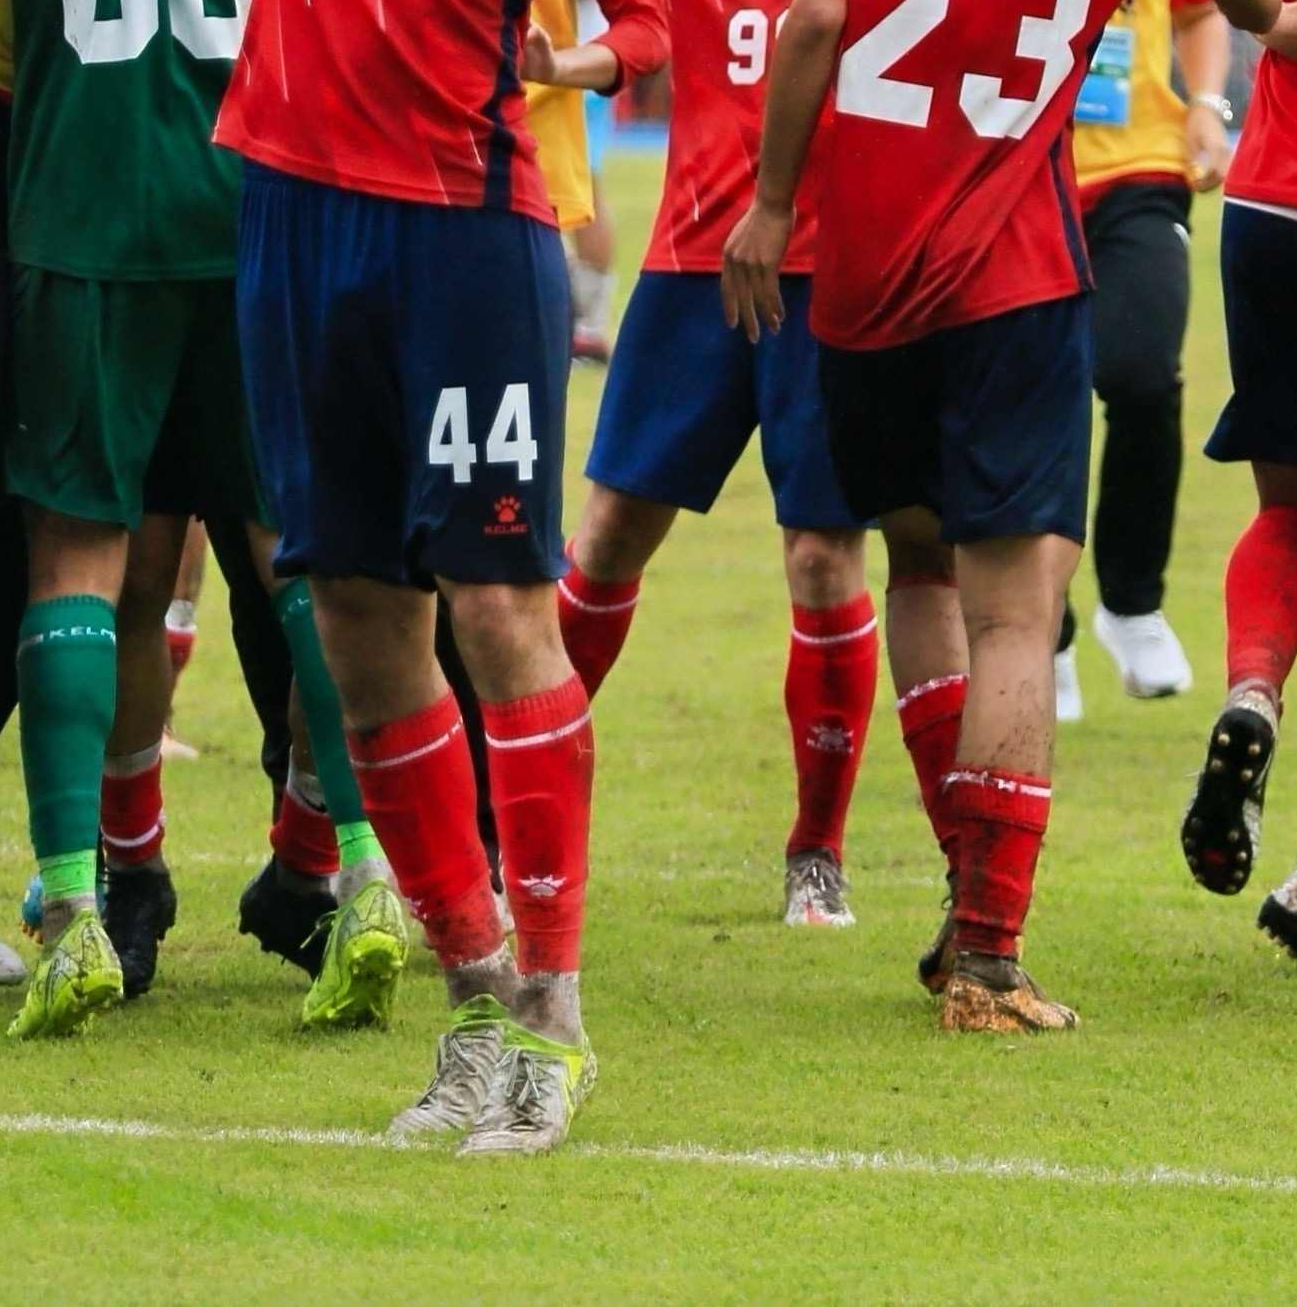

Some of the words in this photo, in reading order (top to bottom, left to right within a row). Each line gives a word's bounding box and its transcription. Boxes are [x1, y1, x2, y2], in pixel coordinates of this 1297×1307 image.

[726, 9, 790, 85] 9
[428, 382, 538, 483] 44
[49, 626, 117, 646] KELM
